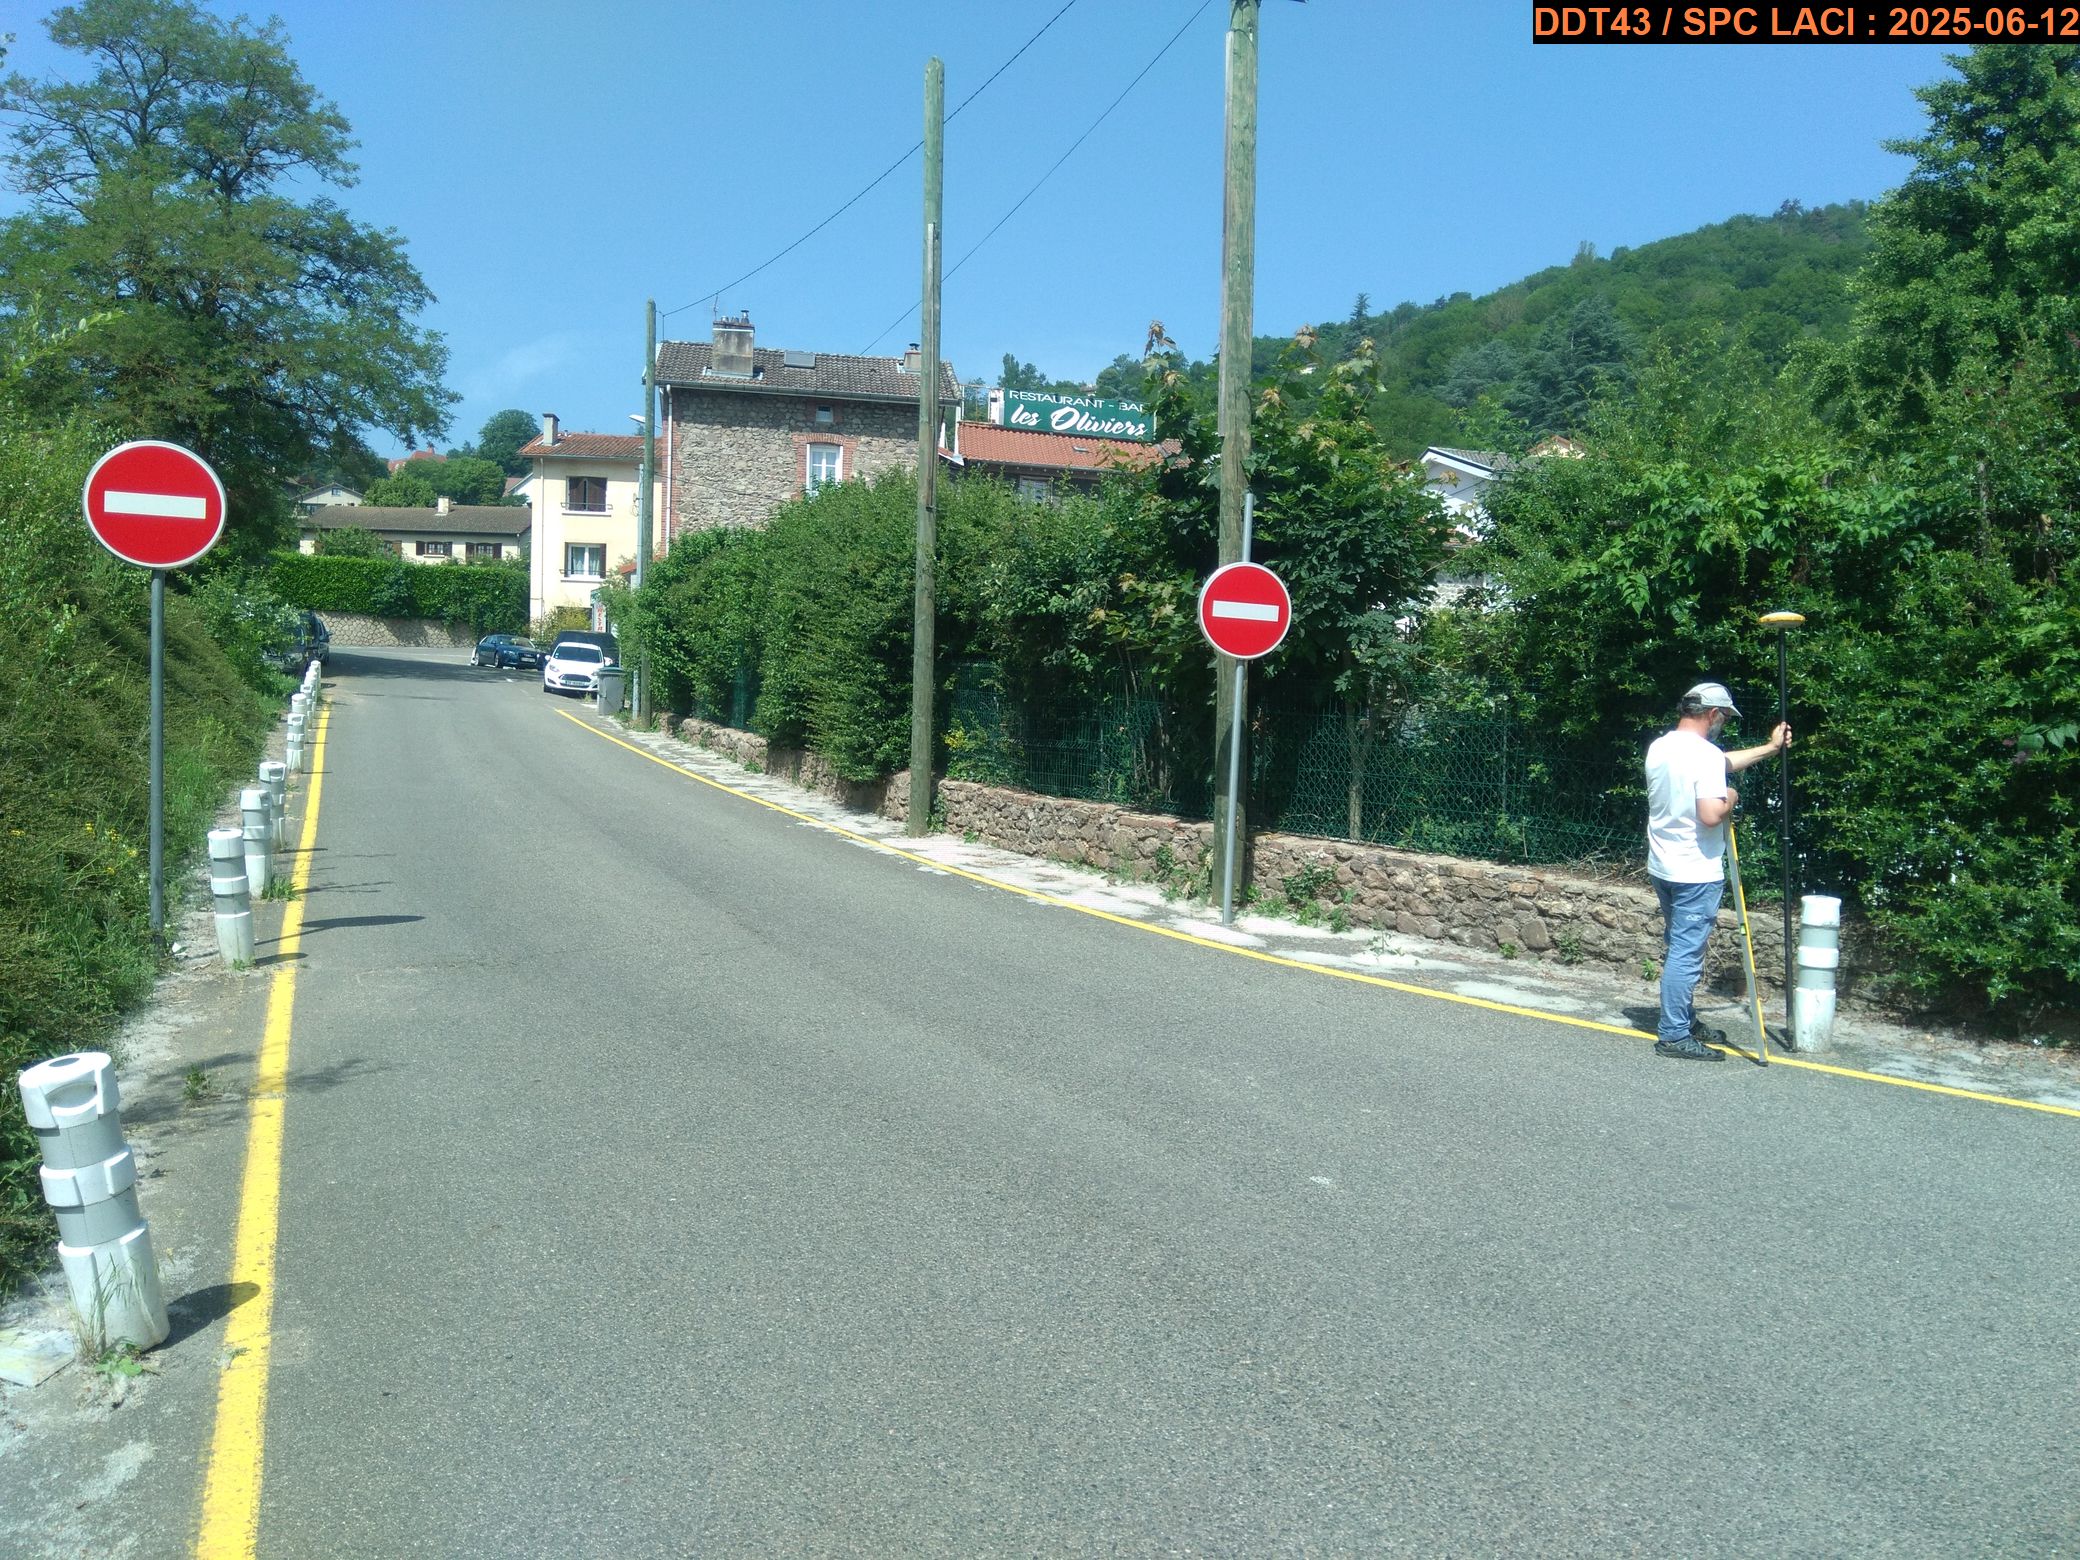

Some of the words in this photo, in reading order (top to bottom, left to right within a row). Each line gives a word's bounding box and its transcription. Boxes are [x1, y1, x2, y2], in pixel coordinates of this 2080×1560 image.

[1010, 390, 1105, 408] RESTAURANT
[1011, 404, 1041, 426] les
[1051, 406, 1147, 436] Oliviers
